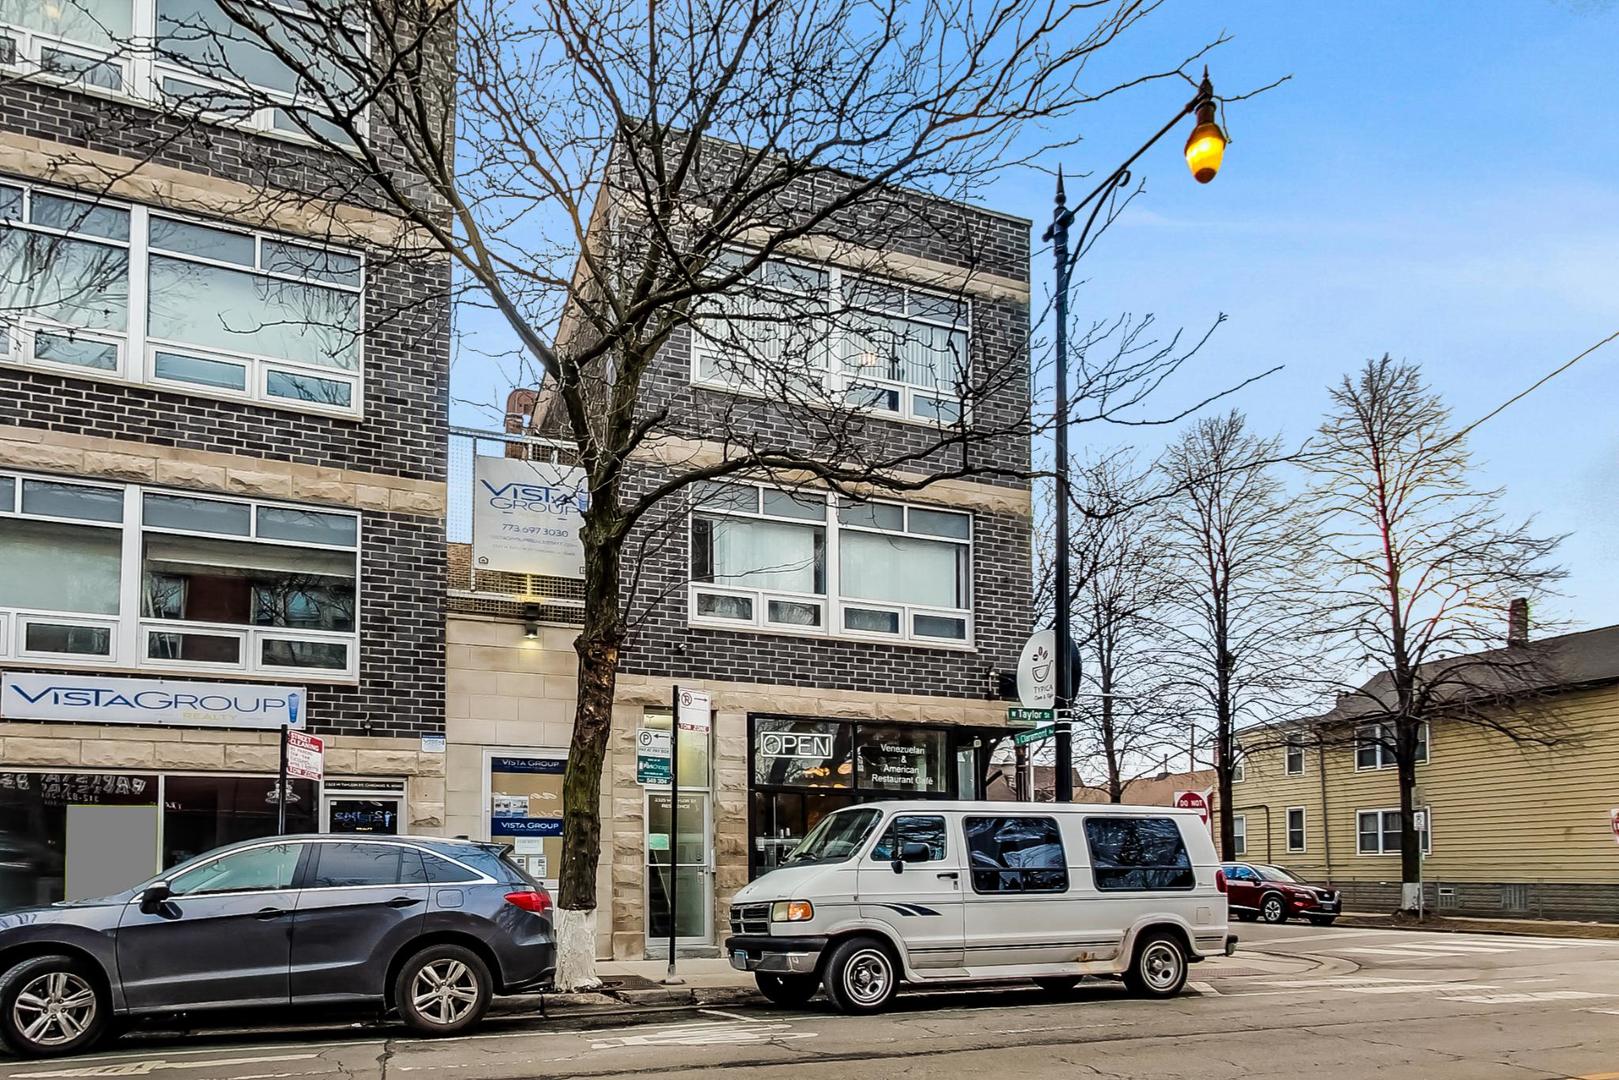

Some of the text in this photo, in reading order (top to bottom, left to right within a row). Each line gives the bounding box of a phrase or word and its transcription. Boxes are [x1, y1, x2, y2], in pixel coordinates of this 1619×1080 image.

[480, 479, 577, 508] VISTA
[490, 497, 581, 516] GROUP
[182, 712, 238, 721] REALTY
[1018, 709, 1042, 720] Taylor
[763, 735, 829, 756] OPEN
[880, 743, 925, 755] Venezuelan
[900, 755, 907, 763] &
[883, 764, 920, 774] American
[871, 773, 914, 784] Restaurant
[1180, 799, 1203, 807] DO NOT
